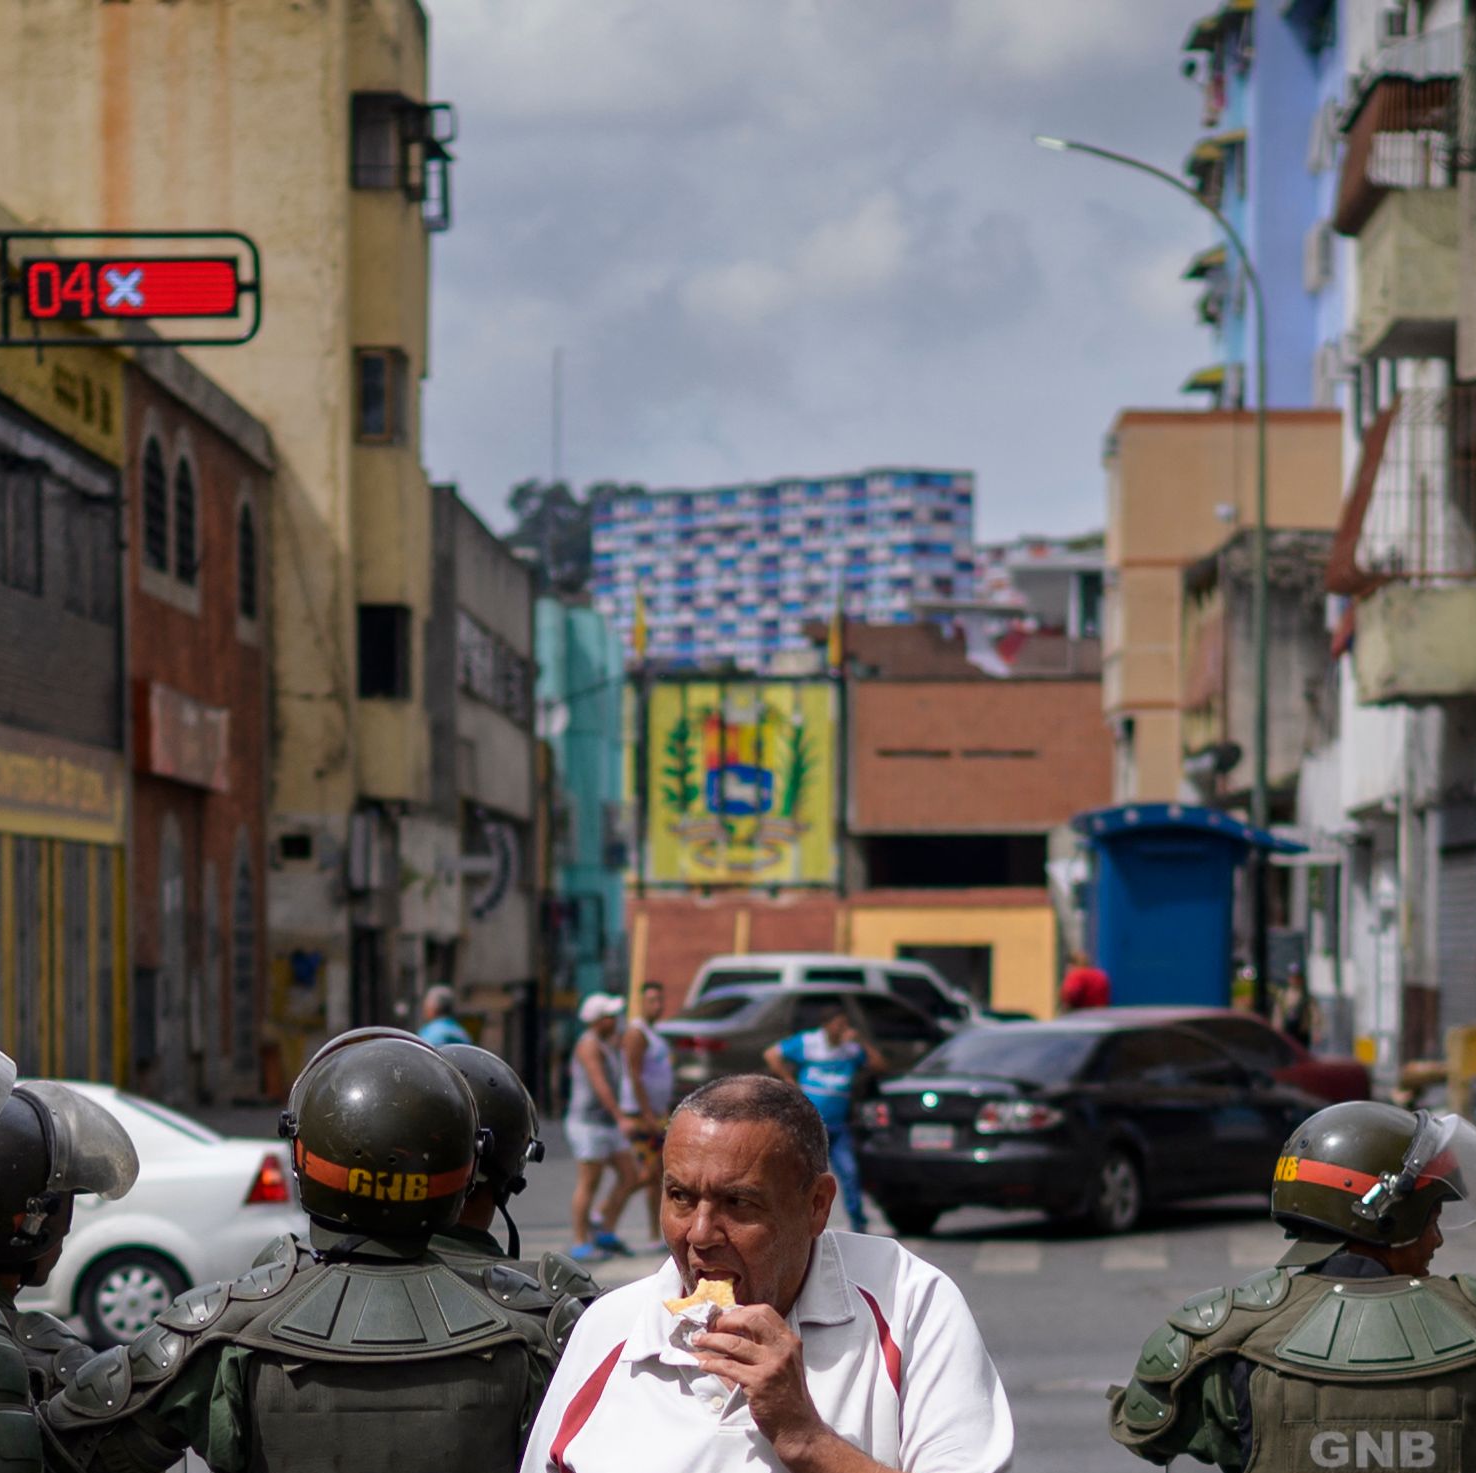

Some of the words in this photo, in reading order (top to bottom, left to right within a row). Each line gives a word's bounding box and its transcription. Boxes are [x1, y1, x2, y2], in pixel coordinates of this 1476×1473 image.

[27, 262, 94, 318] 04
[345, 1167, 430, 1202] GNB
[1309, 1430, 1437, 1469] GNB
